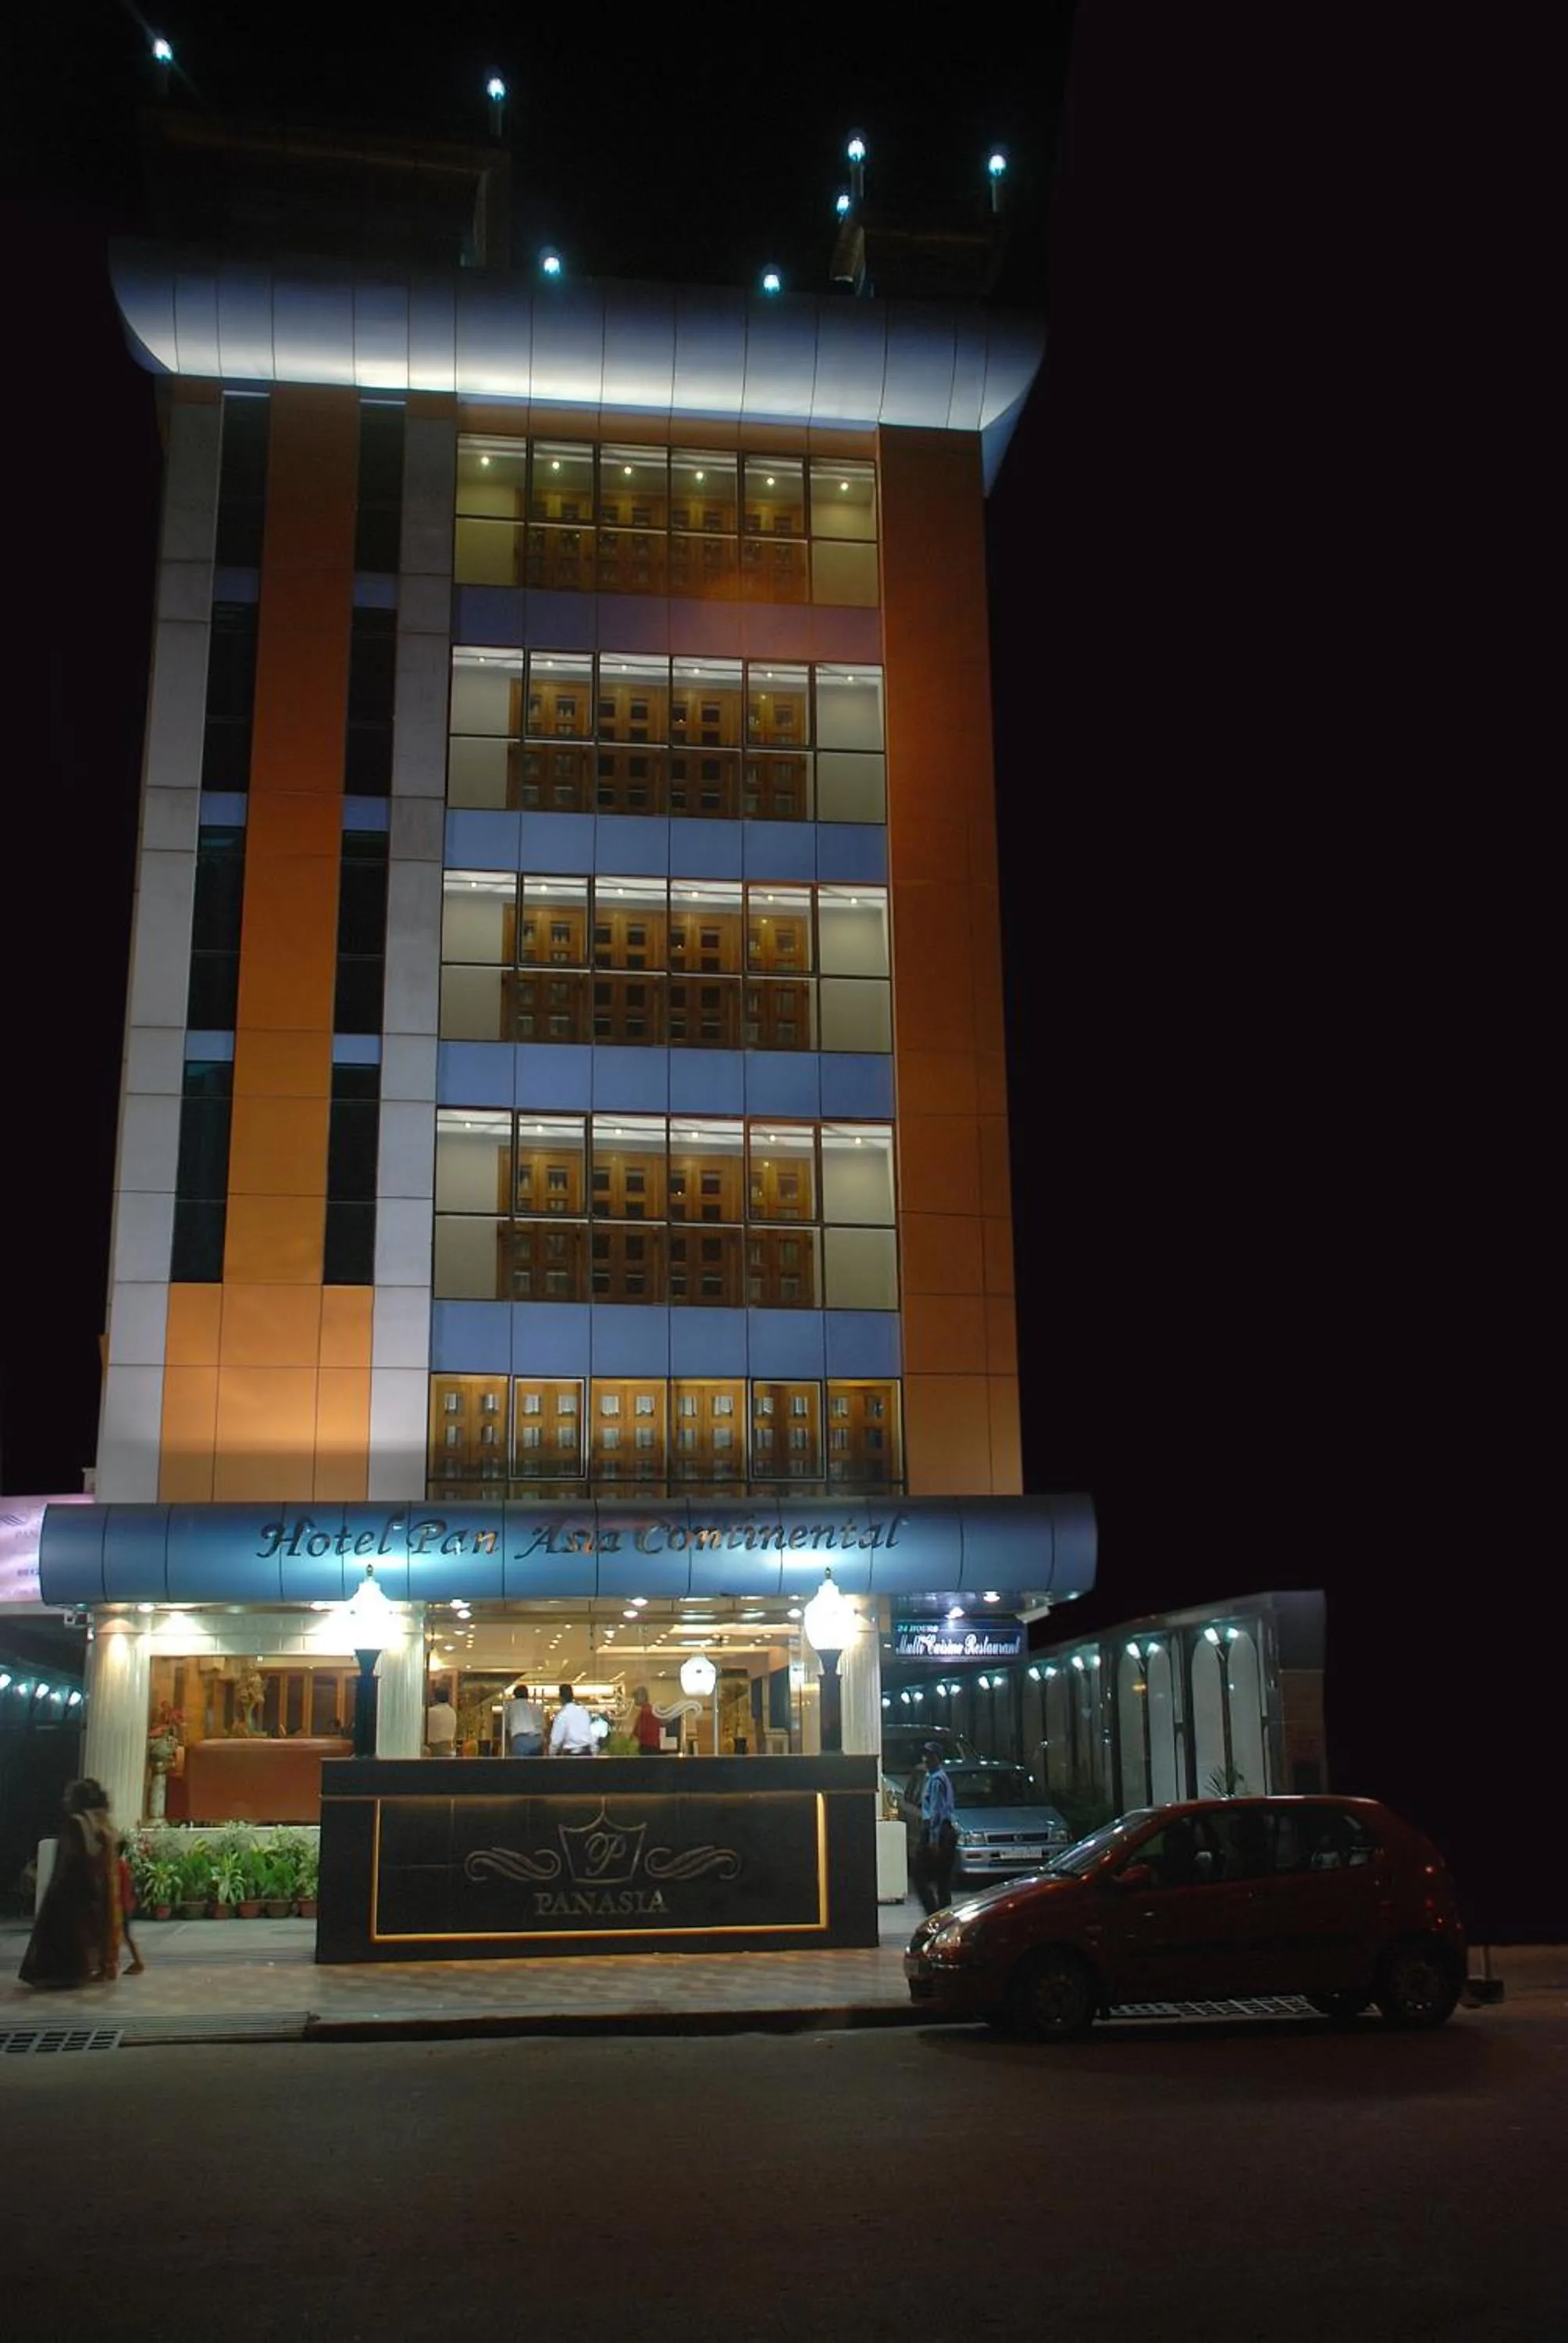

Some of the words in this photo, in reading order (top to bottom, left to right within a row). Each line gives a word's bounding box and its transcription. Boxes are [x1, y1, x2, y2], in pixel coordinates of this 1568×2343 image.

[256, 1514, 405, 1557] Hotel
[406, 1519, 500, 1555] Pan
[515, 1515, 621, 1559] Asia
[633, 1512, 909, 1554] Continental
[535, 1890, 669, 1917] PANASIA
